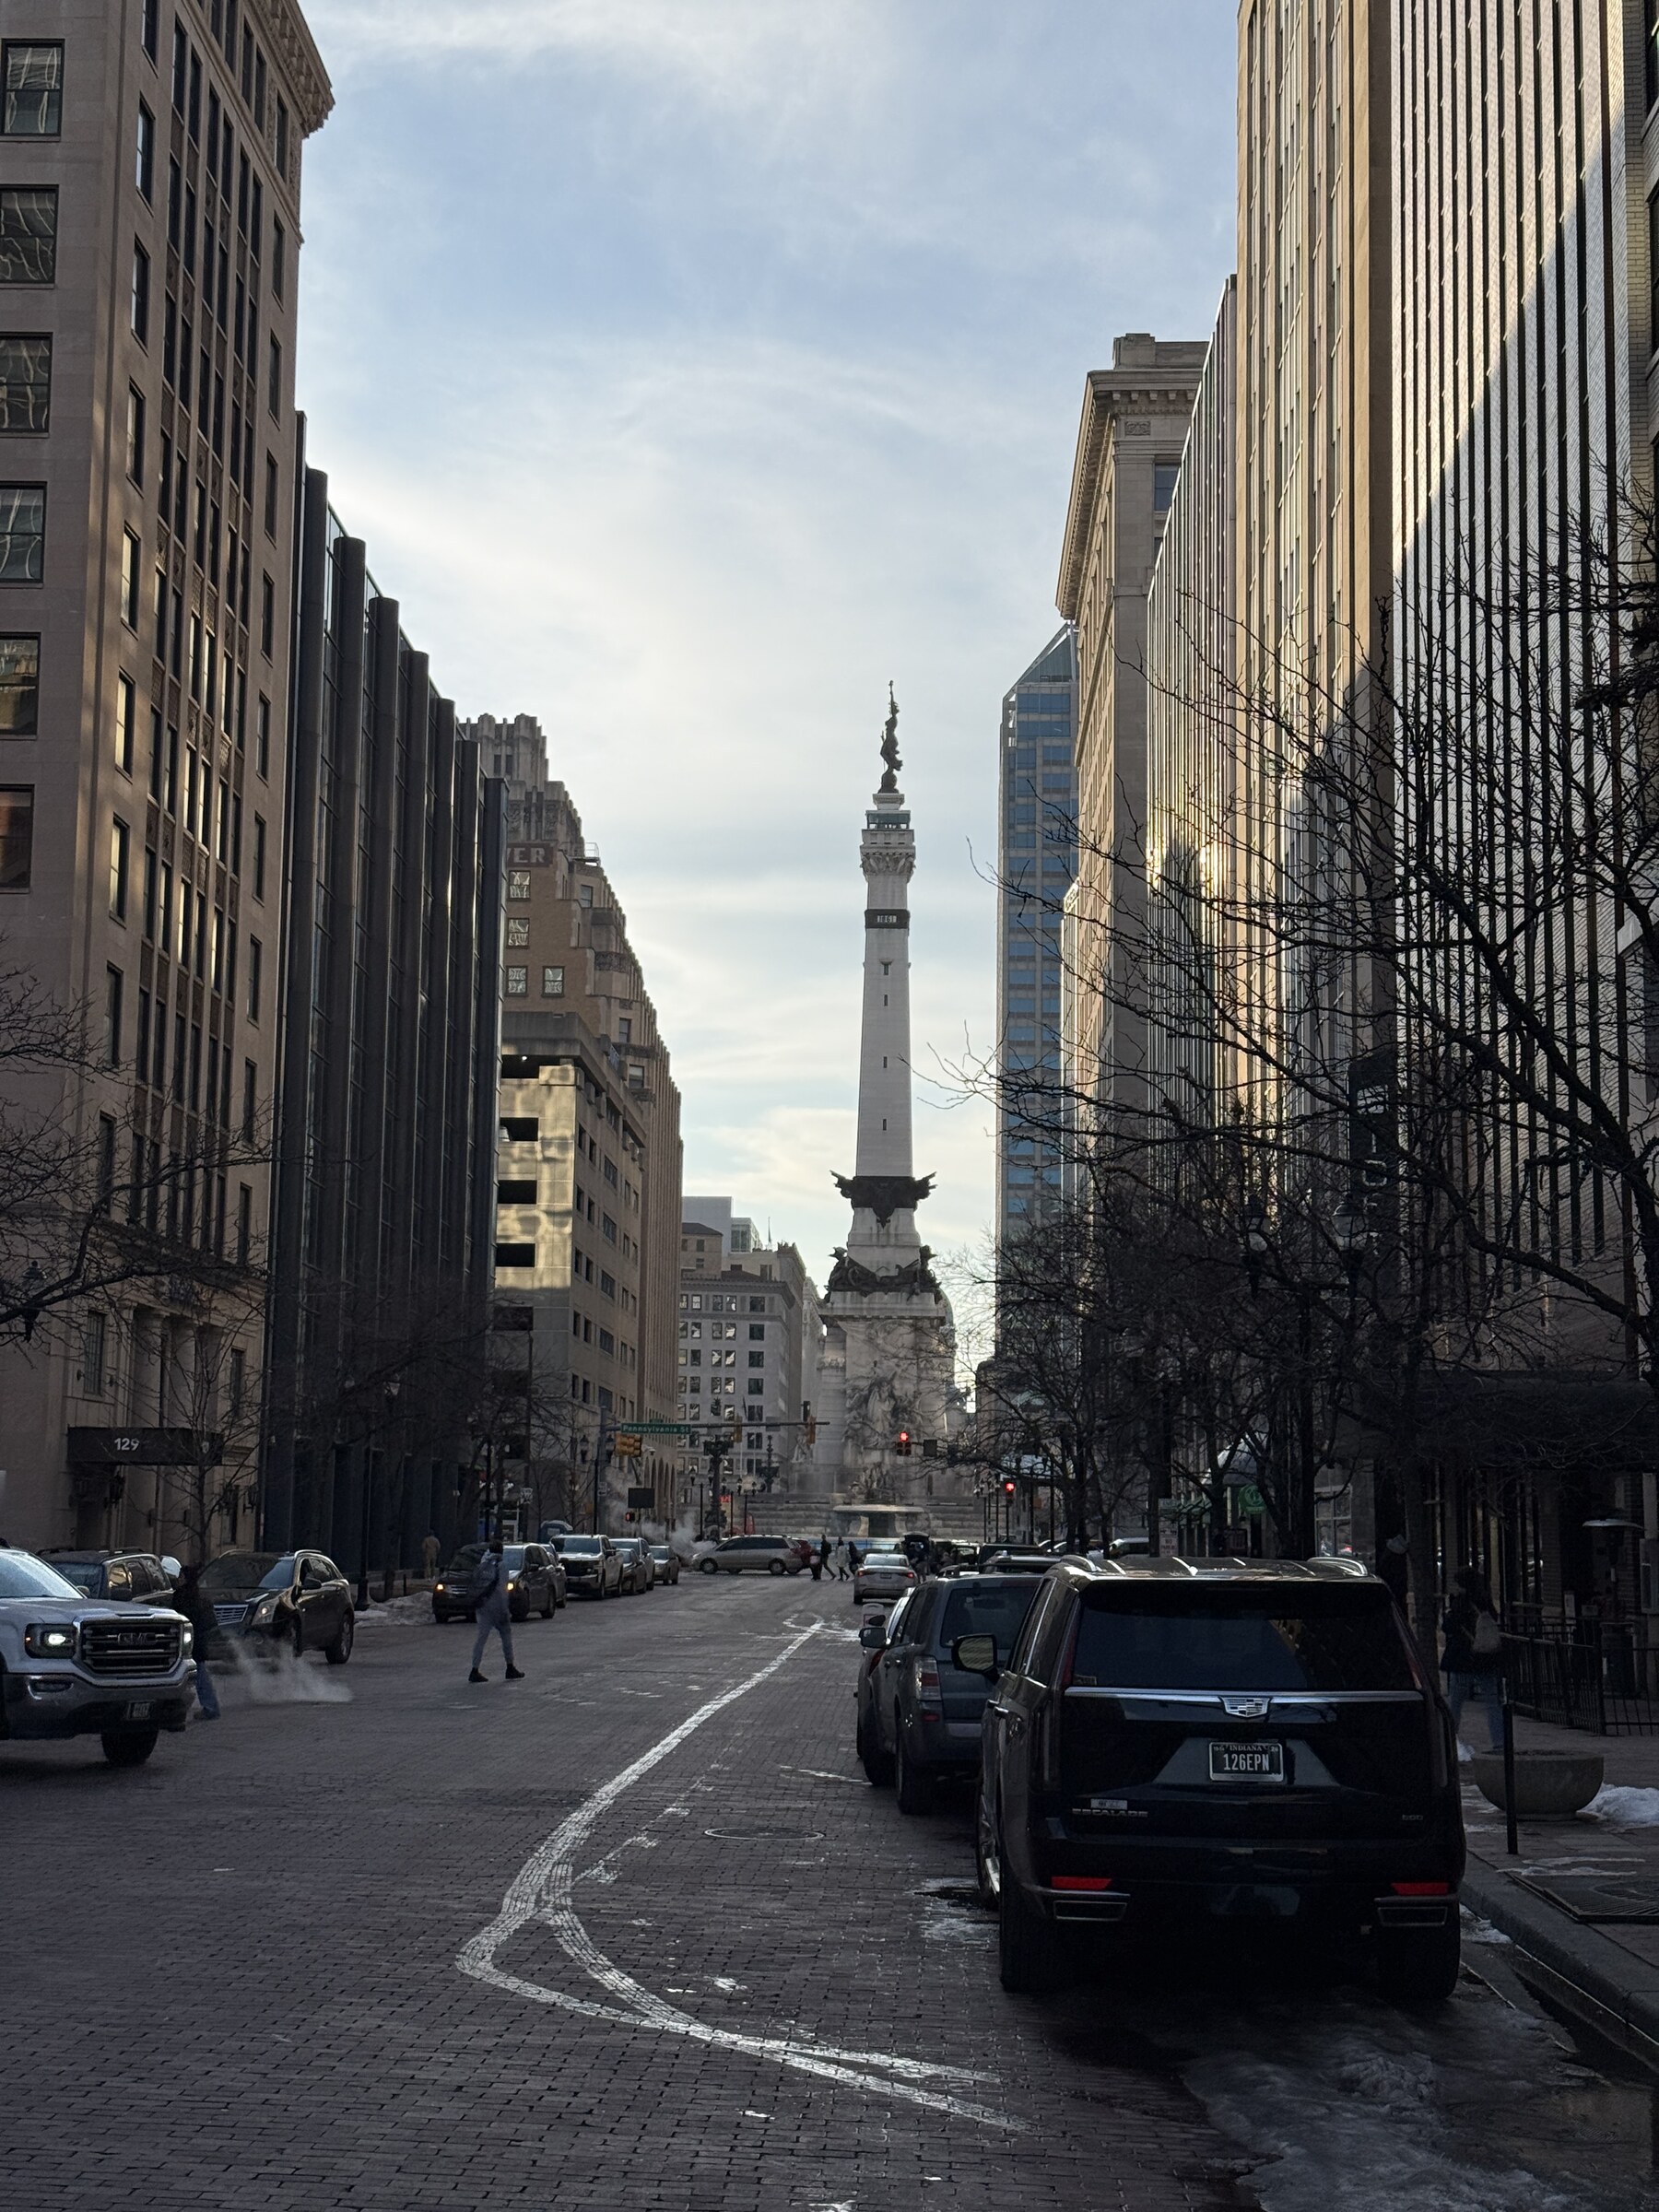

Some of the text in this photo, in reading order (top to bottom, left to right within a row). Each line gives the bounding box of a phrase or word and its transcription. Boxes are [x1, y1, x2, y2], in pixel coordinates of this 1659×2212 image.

[507, 847, 546, 863] ER
[622, 1425, 678, 1434] Pennsylvania
[114, 1437, 140, 1452] 129
[117, 1631, 157, 1645] GMC
[1223, 1753, 1270, 1771] 126EPN
[1072, 1808, 1149, 1818] ESCALADE
